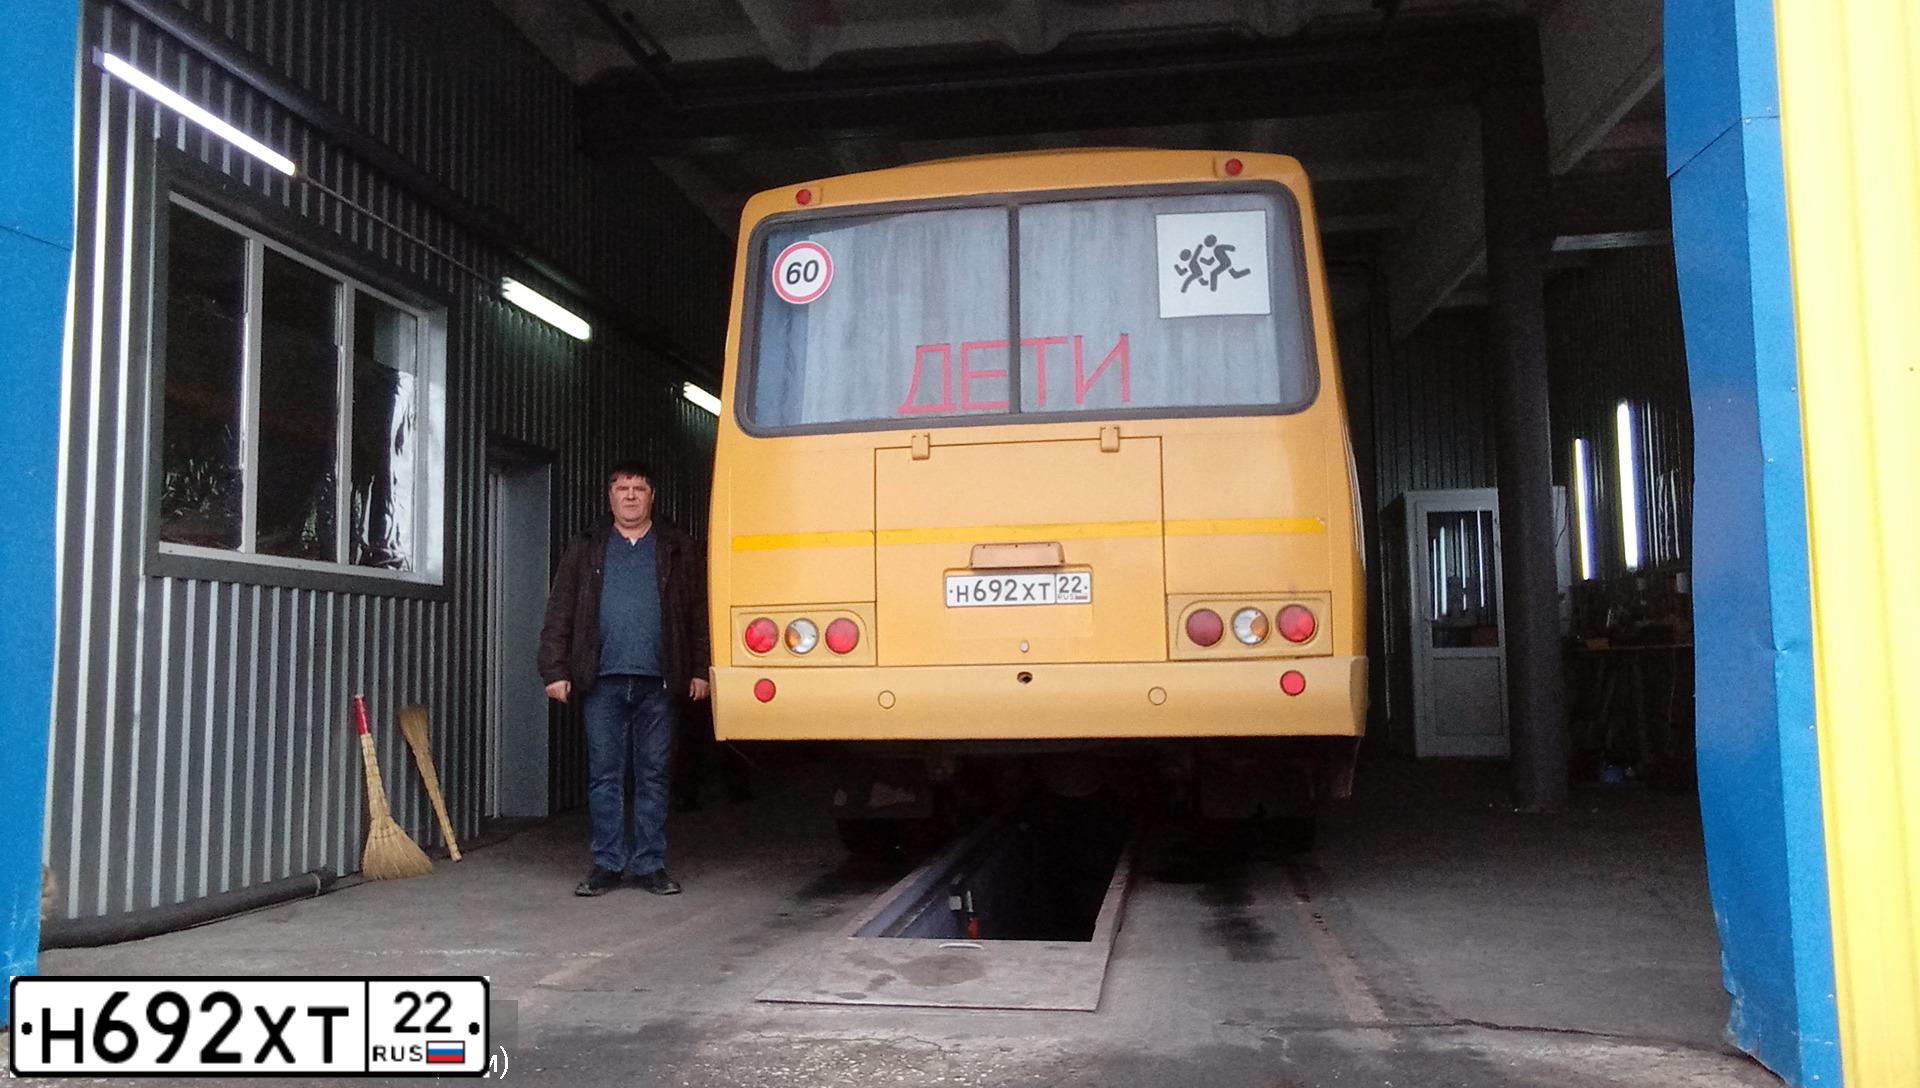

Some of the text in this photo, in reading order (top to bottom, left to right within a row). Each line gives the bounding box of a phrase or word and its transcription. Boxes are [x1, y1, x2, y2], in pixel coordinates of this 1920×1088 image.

[785, 259, 819, 286] 60
[898, 333, 1131, 414] ДЕТИ
[1058, 576, 1082, 593] 22
